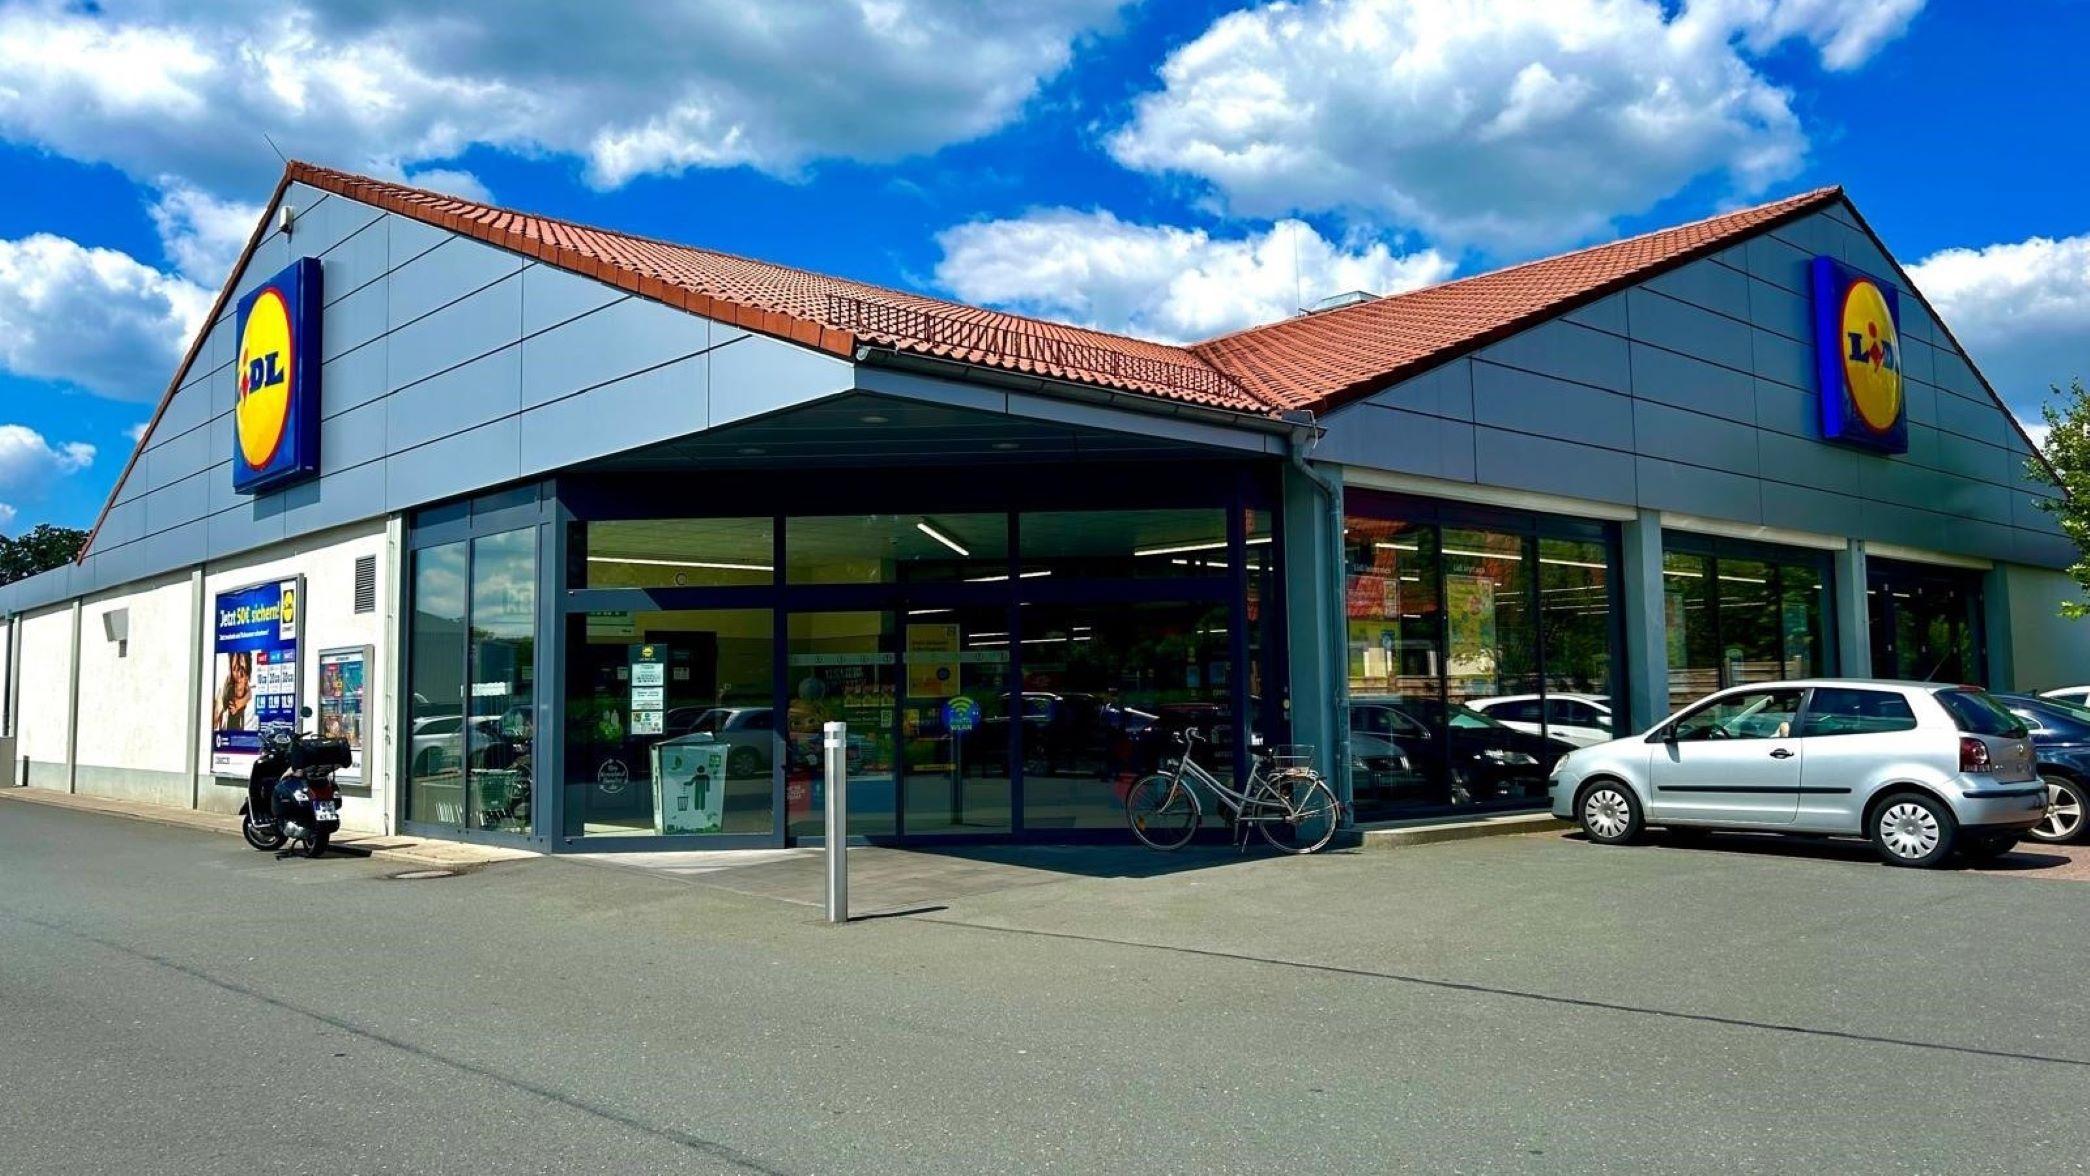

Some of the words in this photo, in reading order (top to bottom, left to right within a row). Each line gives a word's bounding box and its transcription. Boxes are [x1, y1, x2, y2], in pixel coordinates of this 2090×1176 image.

[220, 609, 236, 628] Jetzt
[236, 606, 250, 625] 50€
[251, 600, 280, 624] sichern!
